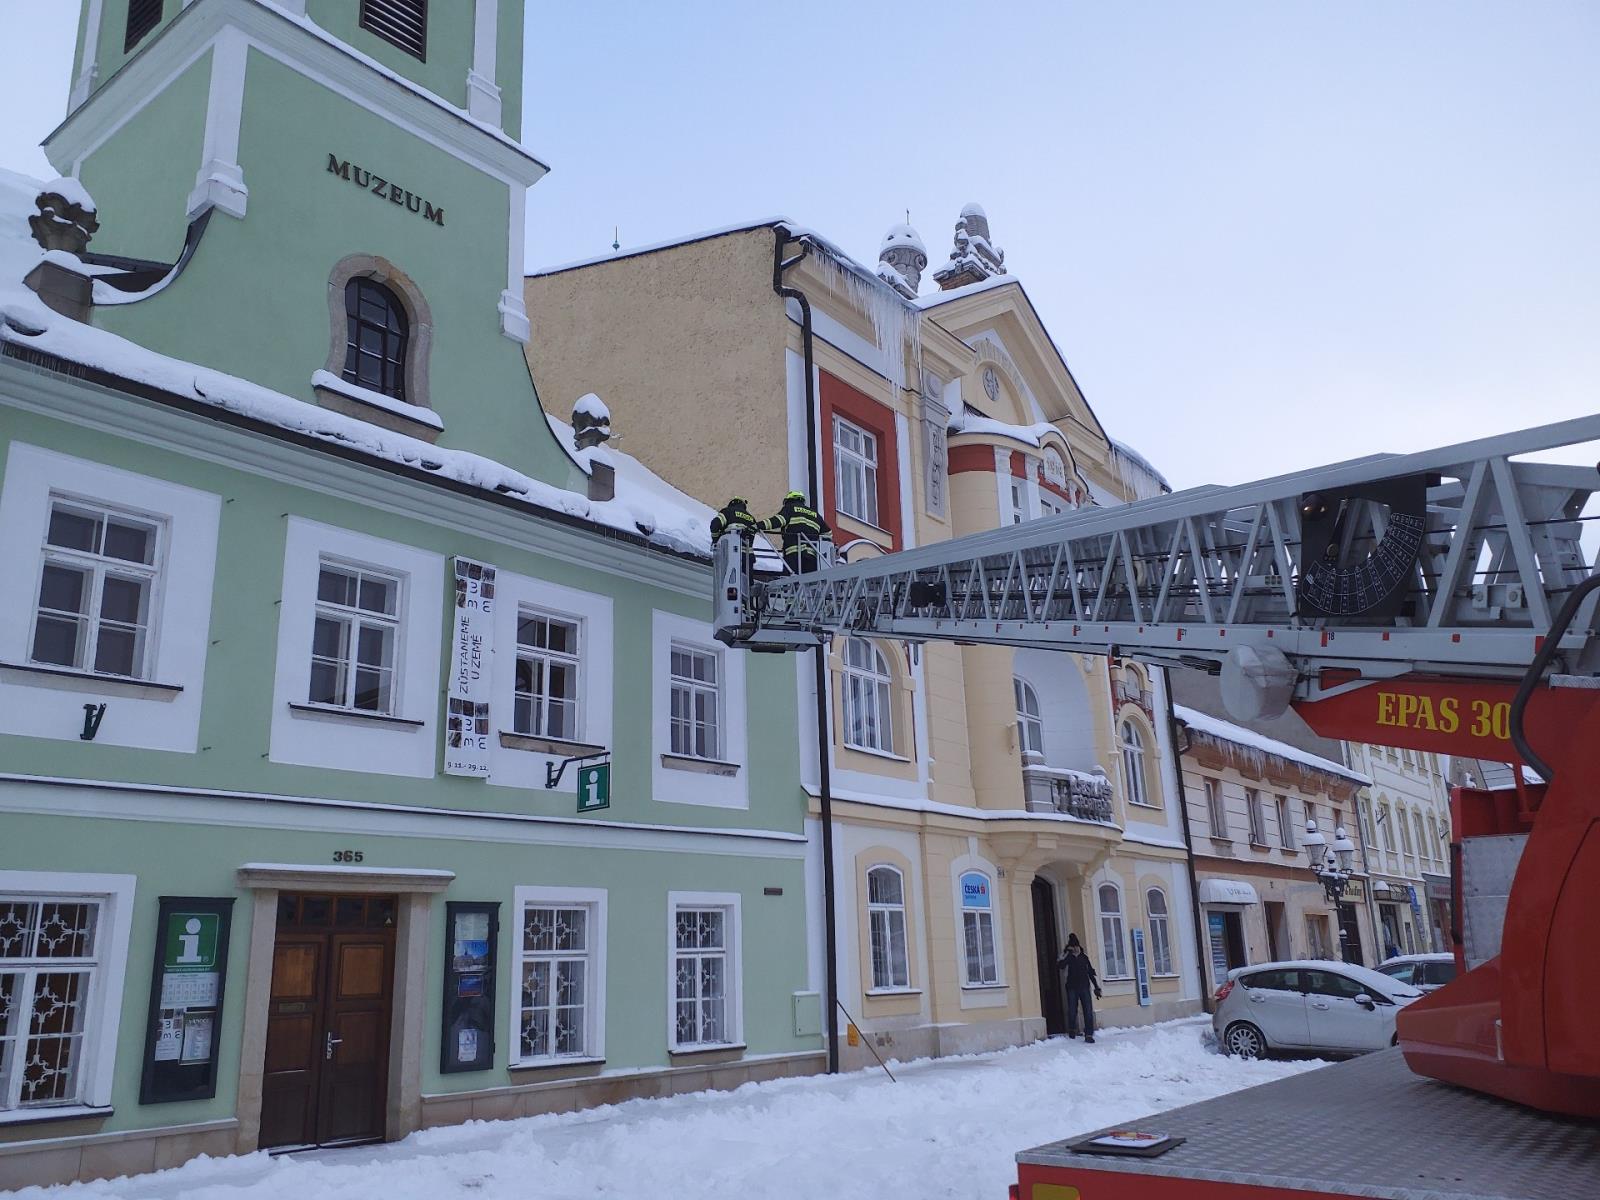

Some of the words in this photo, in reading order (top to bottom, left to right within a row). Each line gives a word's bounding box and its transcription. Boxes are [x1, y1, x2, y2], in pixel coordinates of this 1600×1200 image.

[327, 153, 444, 226] MUZEUM
[458, 616, 470, 694] ZŮSTANEME
[1328, 631, 1335, 640] 18
[1376, 692, 1459, 733] EPAS
[1471, 700, 1511, 740] 30
[333, 850, 363, 862] 365
